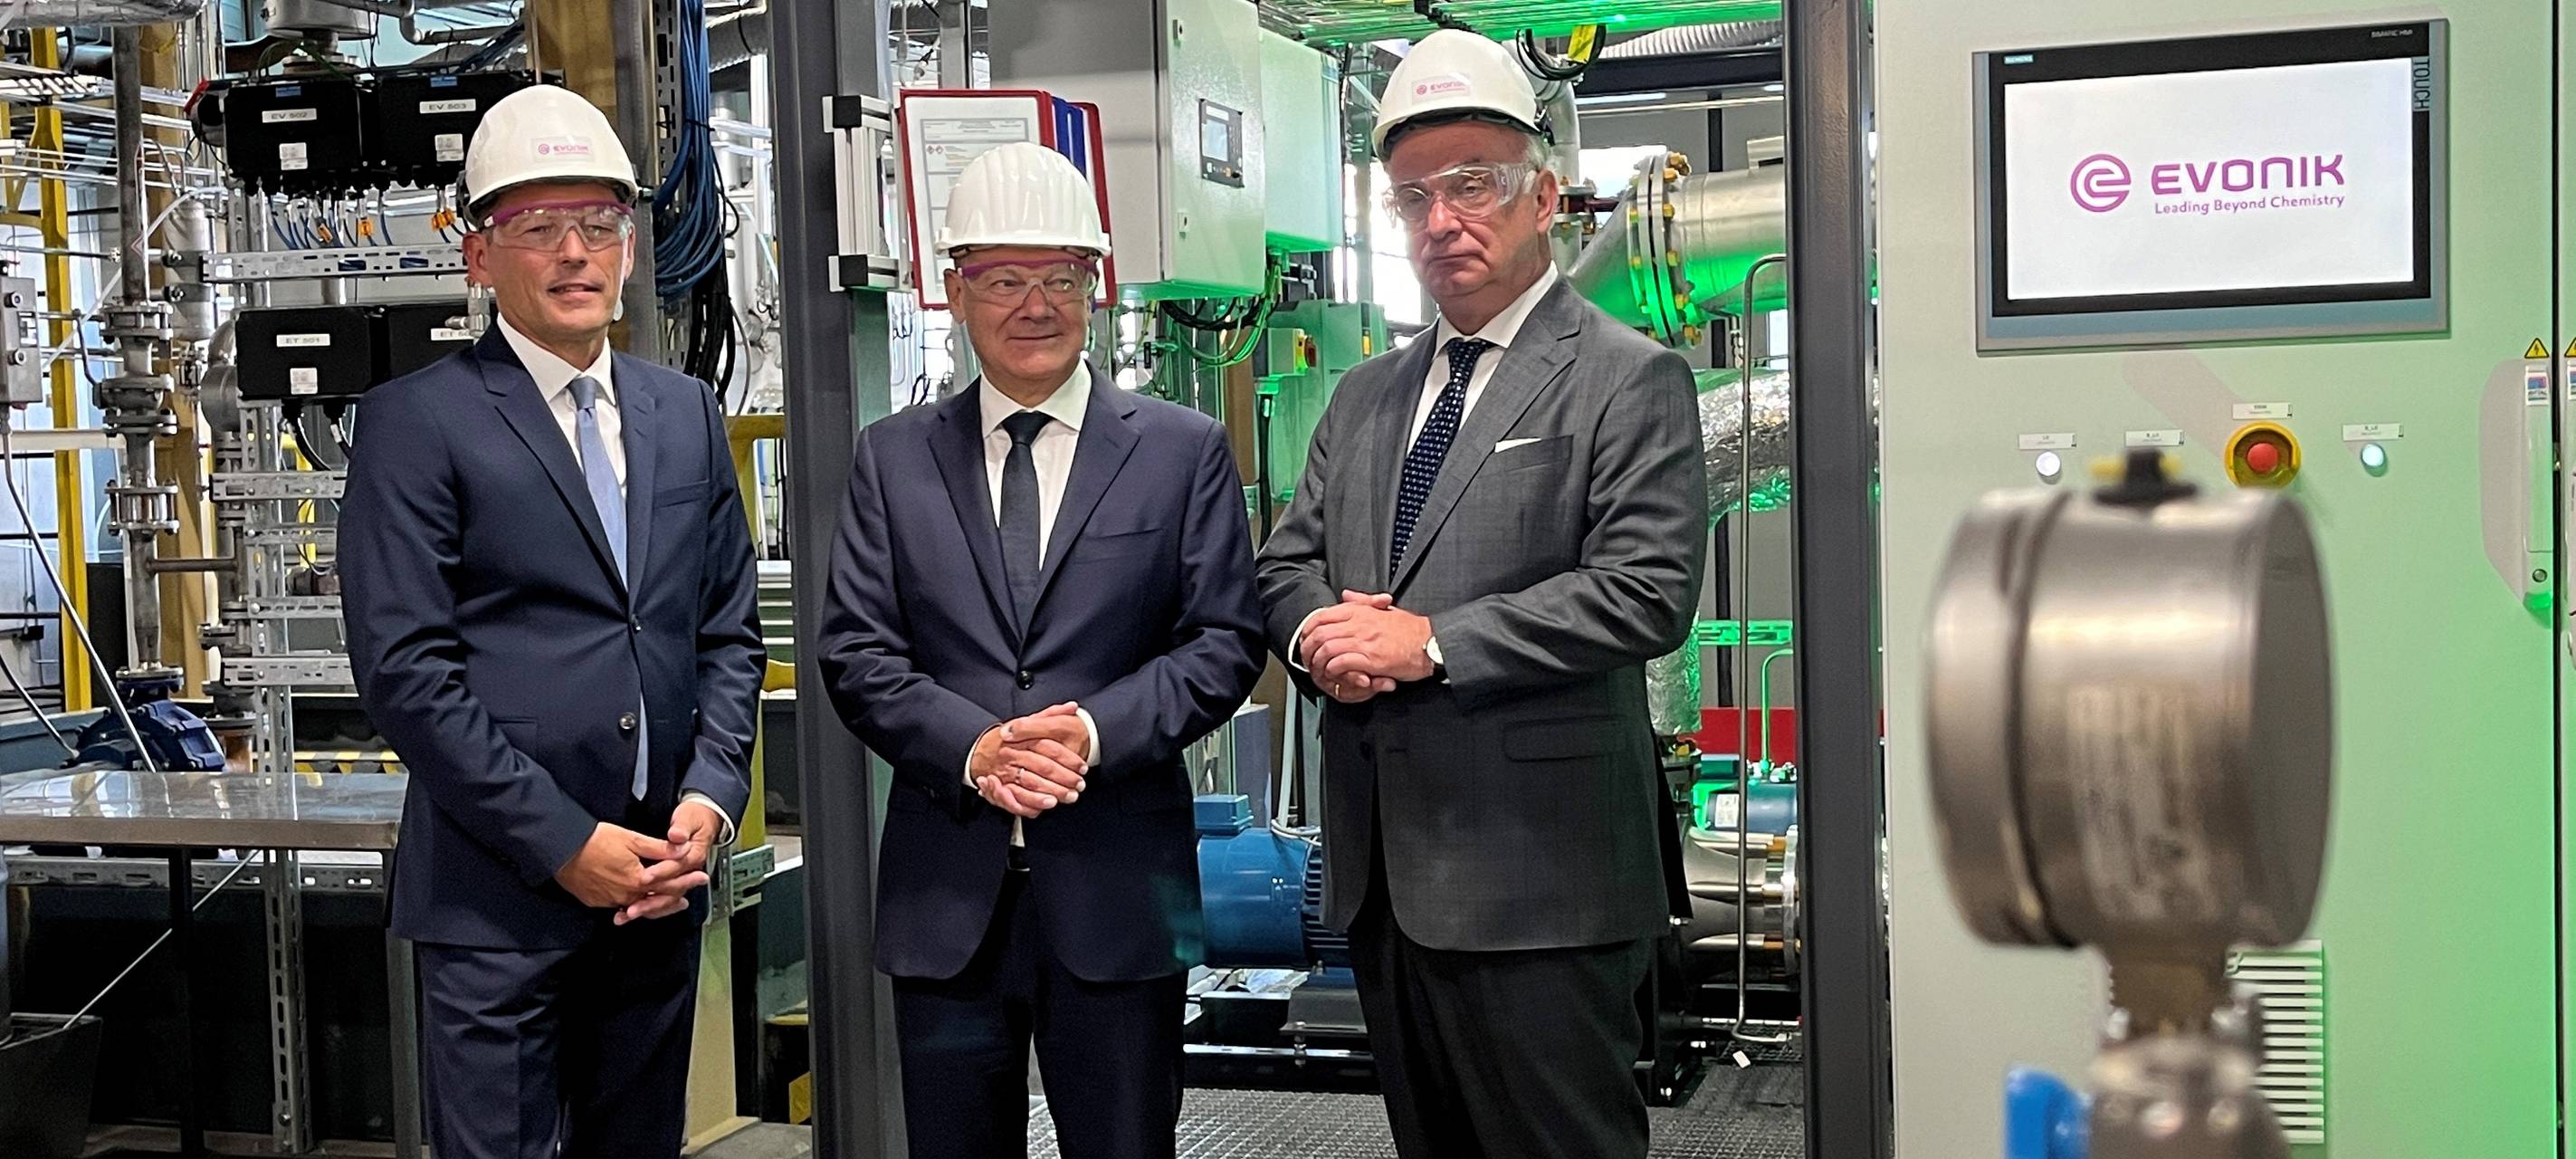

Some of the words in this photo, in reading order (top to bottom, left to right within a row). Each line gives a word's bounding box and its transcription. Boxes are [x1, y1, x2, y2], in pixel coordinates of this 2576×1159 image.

[2412, 57, 2431, 110] TOUCH
[2151, 154, 2345, 195] EVONIK
[2154, 200, 2209, 216] Leading
[2214, 197, 2266, 214] Beyond
[2270, 195, 2345, 209] Chemistry
